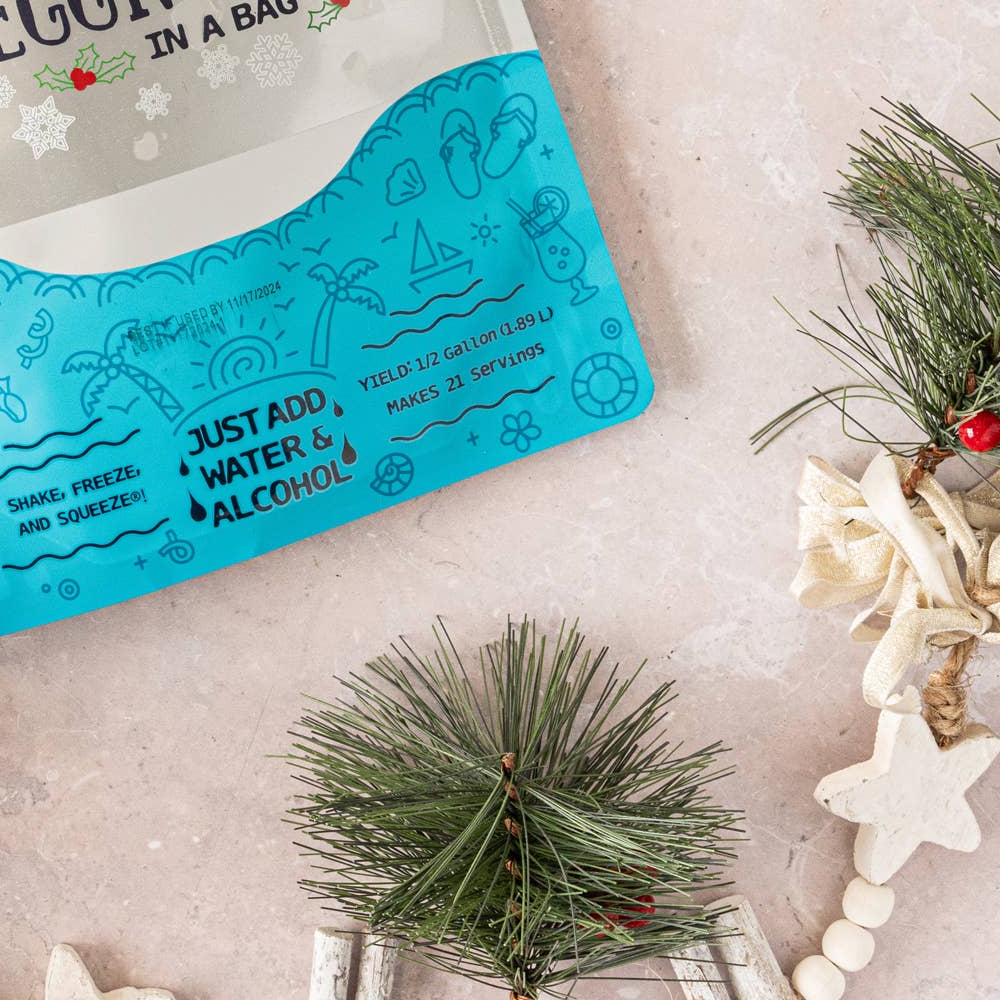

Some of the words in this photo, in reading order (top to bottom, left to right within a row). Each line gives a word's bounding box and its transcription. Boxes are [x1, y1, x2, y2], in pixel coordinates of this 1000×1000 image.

[144, 23, 189, 59] IN
[202, 14, 225, 43] A
[210, 300, 226, 318] BY
[227, 280, 281, 311] 11/17/2024
[358, 361, 413, 393] YIELD:
[415, 352, 440, 372] 1/2
[443, 328, 498, 361] Gallon
[499, 313, 536, 338] (1.89
[538, 306, 553, 323] L)
[386, 384, 440, 415] MAKES
[445, 374, 465, 393] 21
[187, 407, 259, 456] JUST
[268, 387, 326, 430] ADD
[199, 434, 306, 490] WATER
[311, 425, 334, 451] &
[7, 488, 66, 513] SHAKE,
[71, 464, 141, 496] FREEZE,
[213, 458, 353, 528] ALCOHOL
[18, 516, 50, 537] AND
